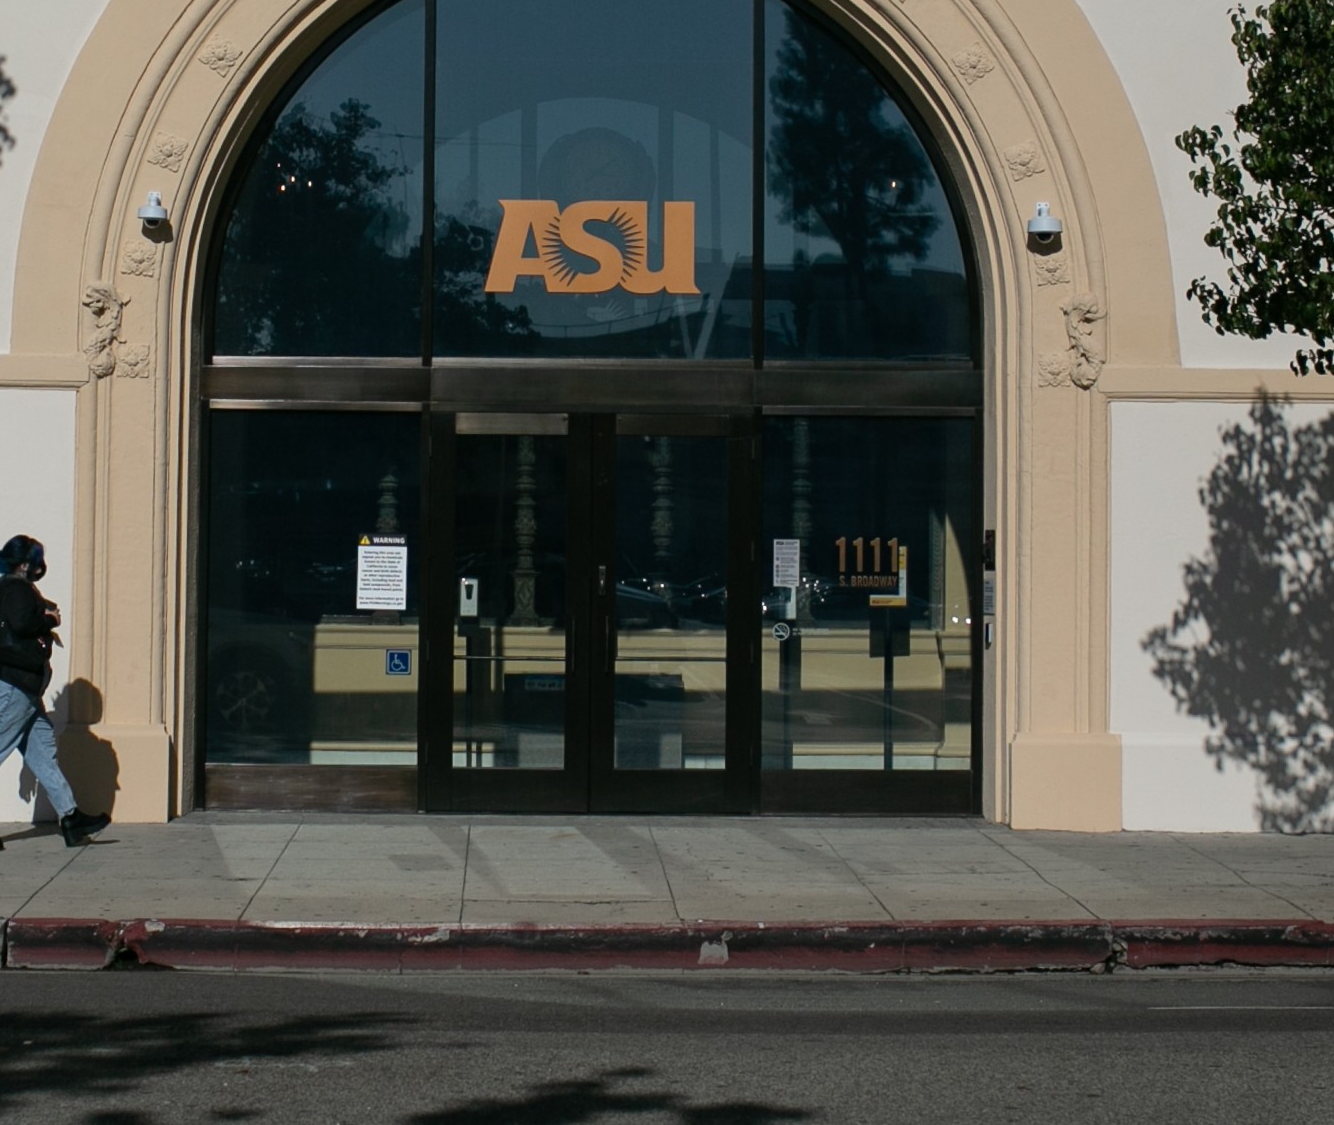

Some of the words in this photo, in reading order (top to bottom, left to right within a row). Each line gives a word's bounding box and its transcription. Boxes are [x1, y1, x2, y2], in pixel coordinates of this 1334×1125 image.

[484, 199, 701, 294] ASU
[835, 536, 898, 572] 1111
[839, 575, 849, 587] S.
[851, 575, 898, 587] BROADWAY
